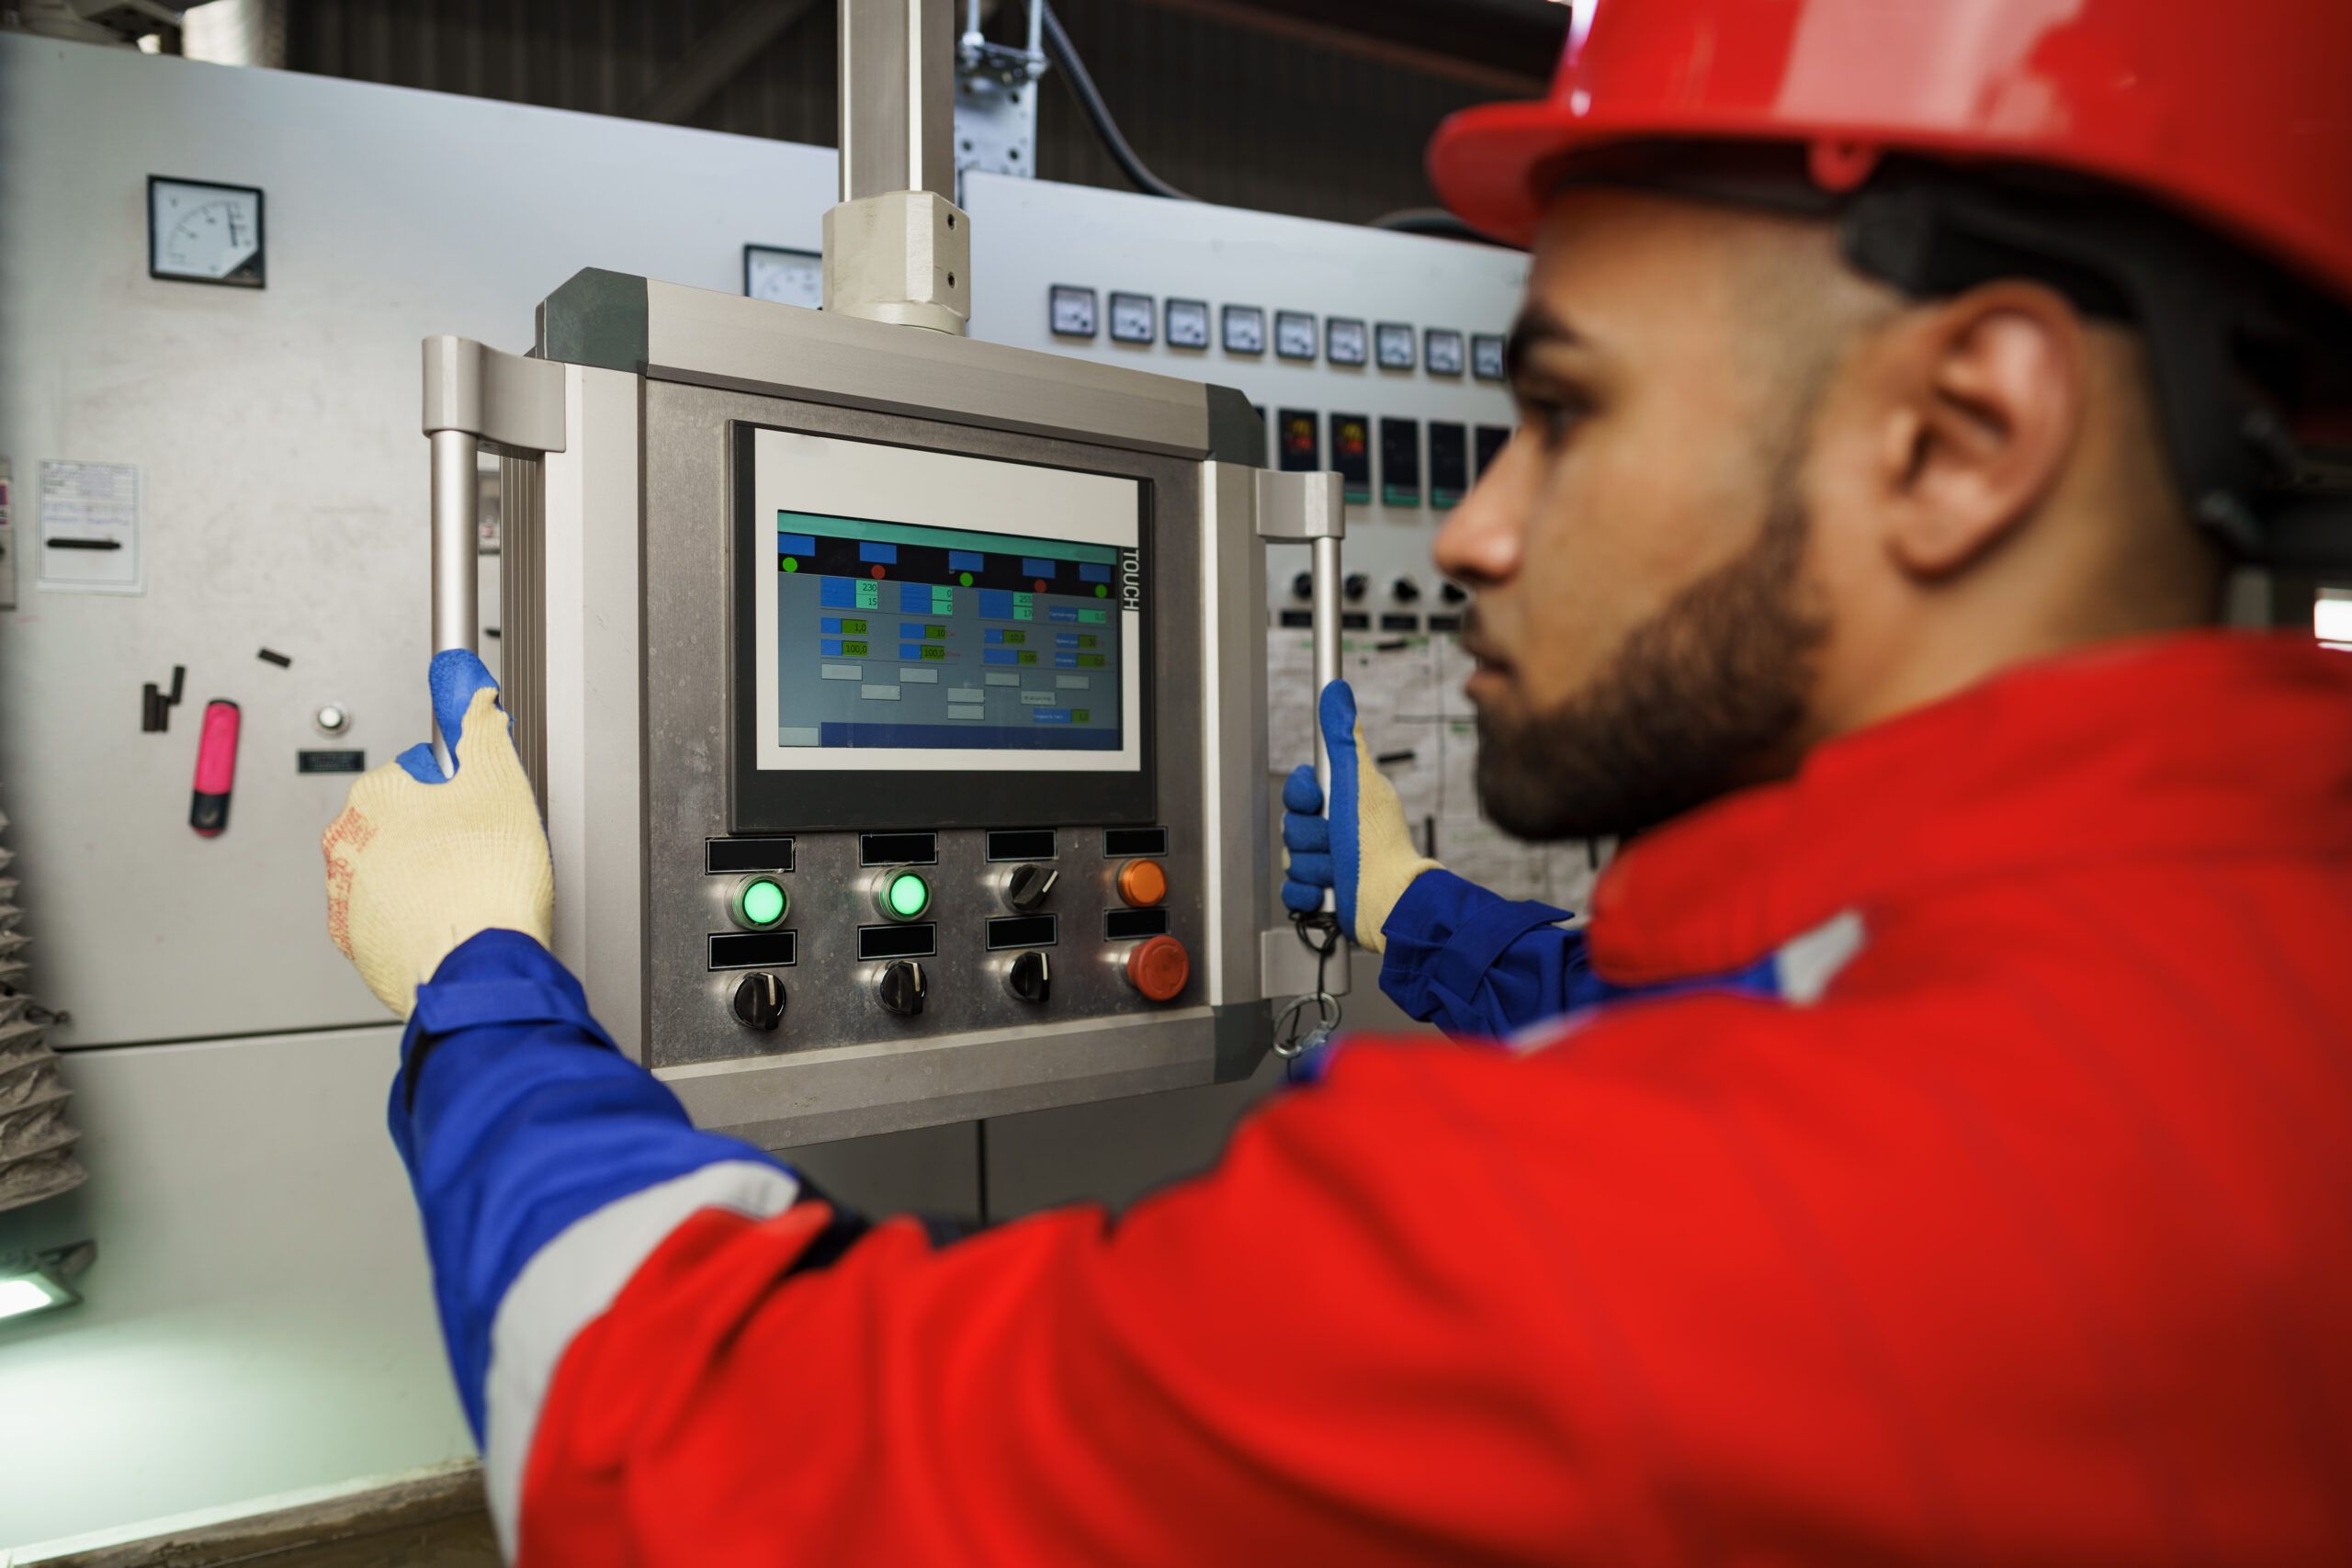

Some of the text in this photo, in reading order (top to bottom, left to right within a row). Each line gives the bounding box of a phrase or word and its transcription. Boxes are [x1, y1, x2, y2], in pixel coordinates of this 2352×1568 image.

[1124, 549, 1139, 610] TOUCH
[862, 583, 877, 592] 230
[946, 590, 952, 598] 0
[868, 597, 877, 606] 15
[946, 604, 952, 613] 0
[854, 624, 866, 633] 1,0
[845, 645, 868, 655] 100,0
